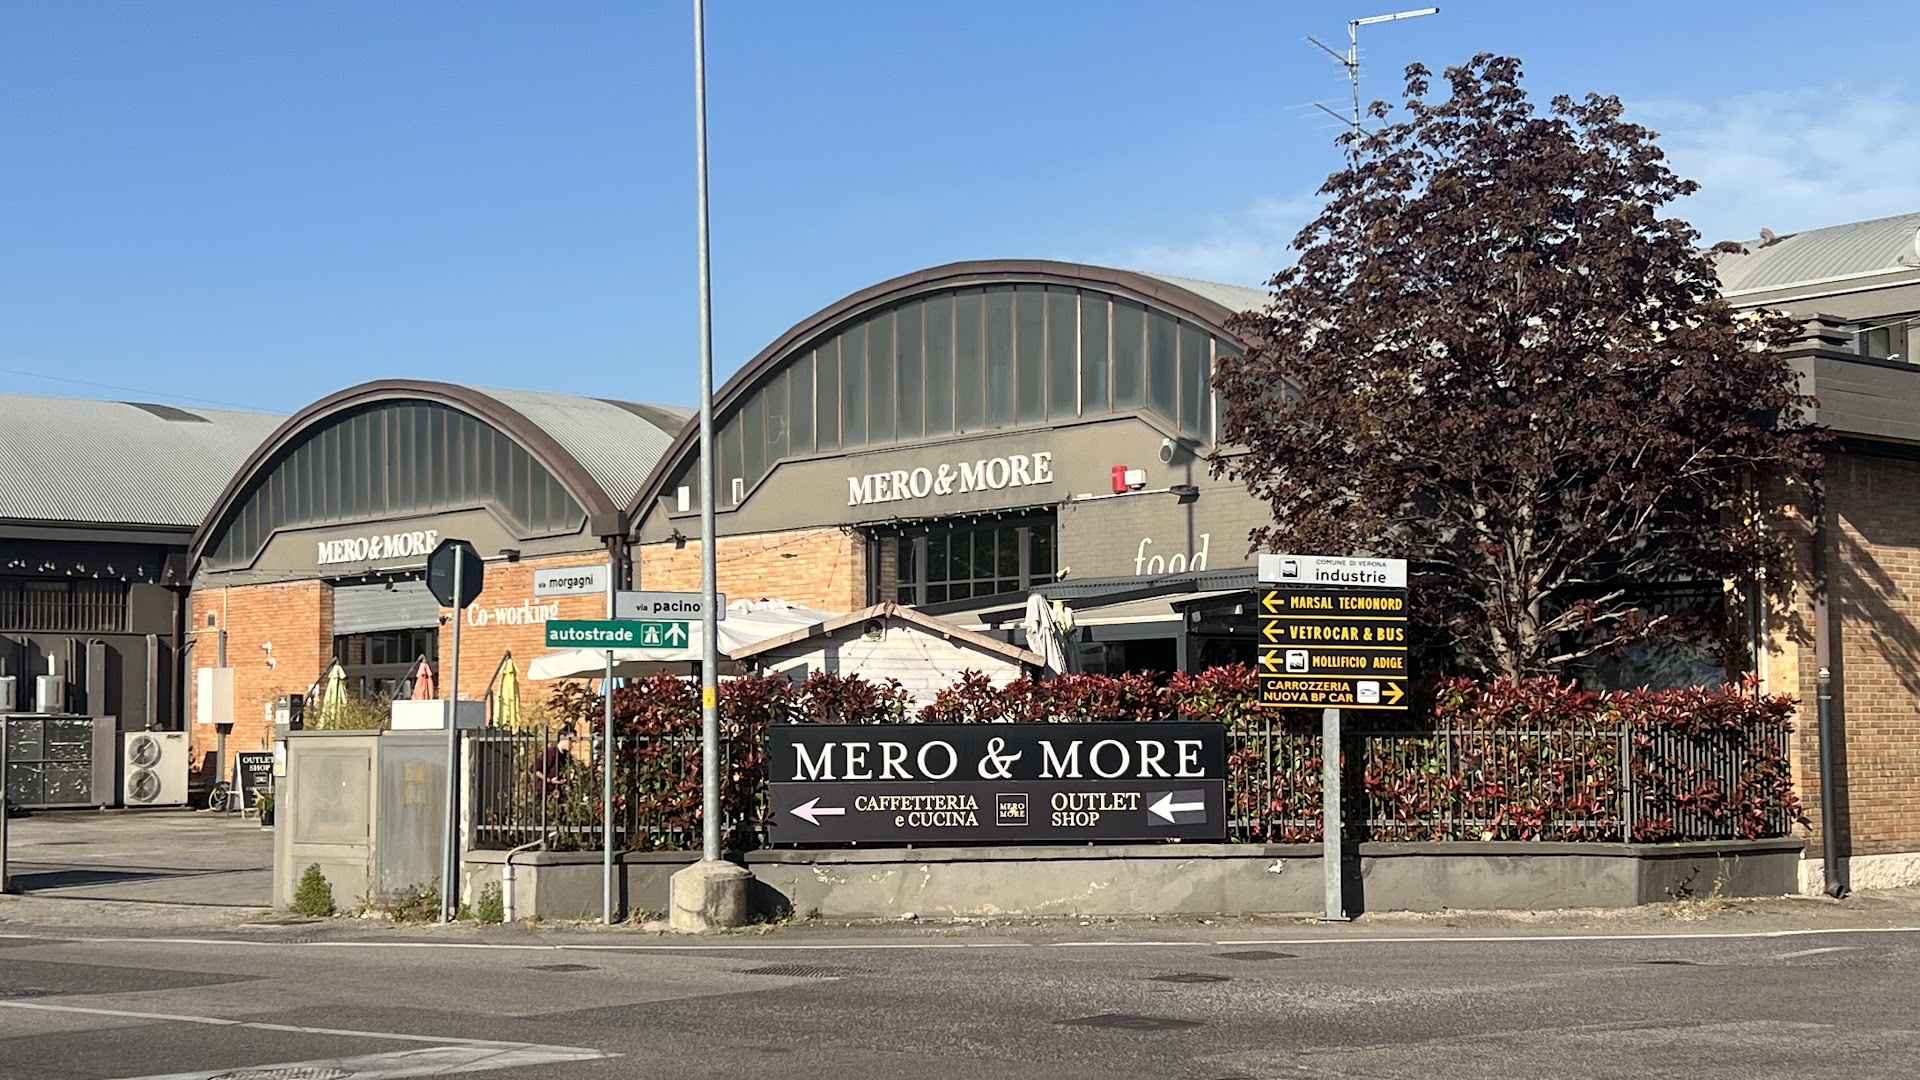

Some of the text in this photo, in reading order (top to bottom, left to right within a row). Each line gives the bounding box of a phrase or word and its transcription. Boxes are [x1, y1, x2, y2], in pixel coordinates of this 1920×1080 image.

[847, 451, 1054, 506] MERO&MORE
[317, 529, 438, 565] MERO&MORE
[1134, 533, 1210, 576] food
[549, 573, 594, 589] morgagni
[1315, 568, 1387, 583] industrie
[1290, 596, 1403, 610] MARSAL TECNONORD
[467, 598, 560, 627] Co-working
[549, 627, 634, 641] autostrade
[1289, 625, 1404, 641] VETROCAR & BUS
[1312, 655, 1403, 669] MOLLIFICIO ADIGE
[1266, 680, 1350, 691] CARROZZERIA
[1263, 691, 1353, 702] NUOVA BP CAR
[790, 736, 1206, 781] MERO & MORE
[855, 795, 979, 811] CAFFETTERIA
[1051, 792, 1141, 811] OUTLET
[895, 811, 979, 827] e CUCINA
[1051, 811, 1100, 827] SHOP
